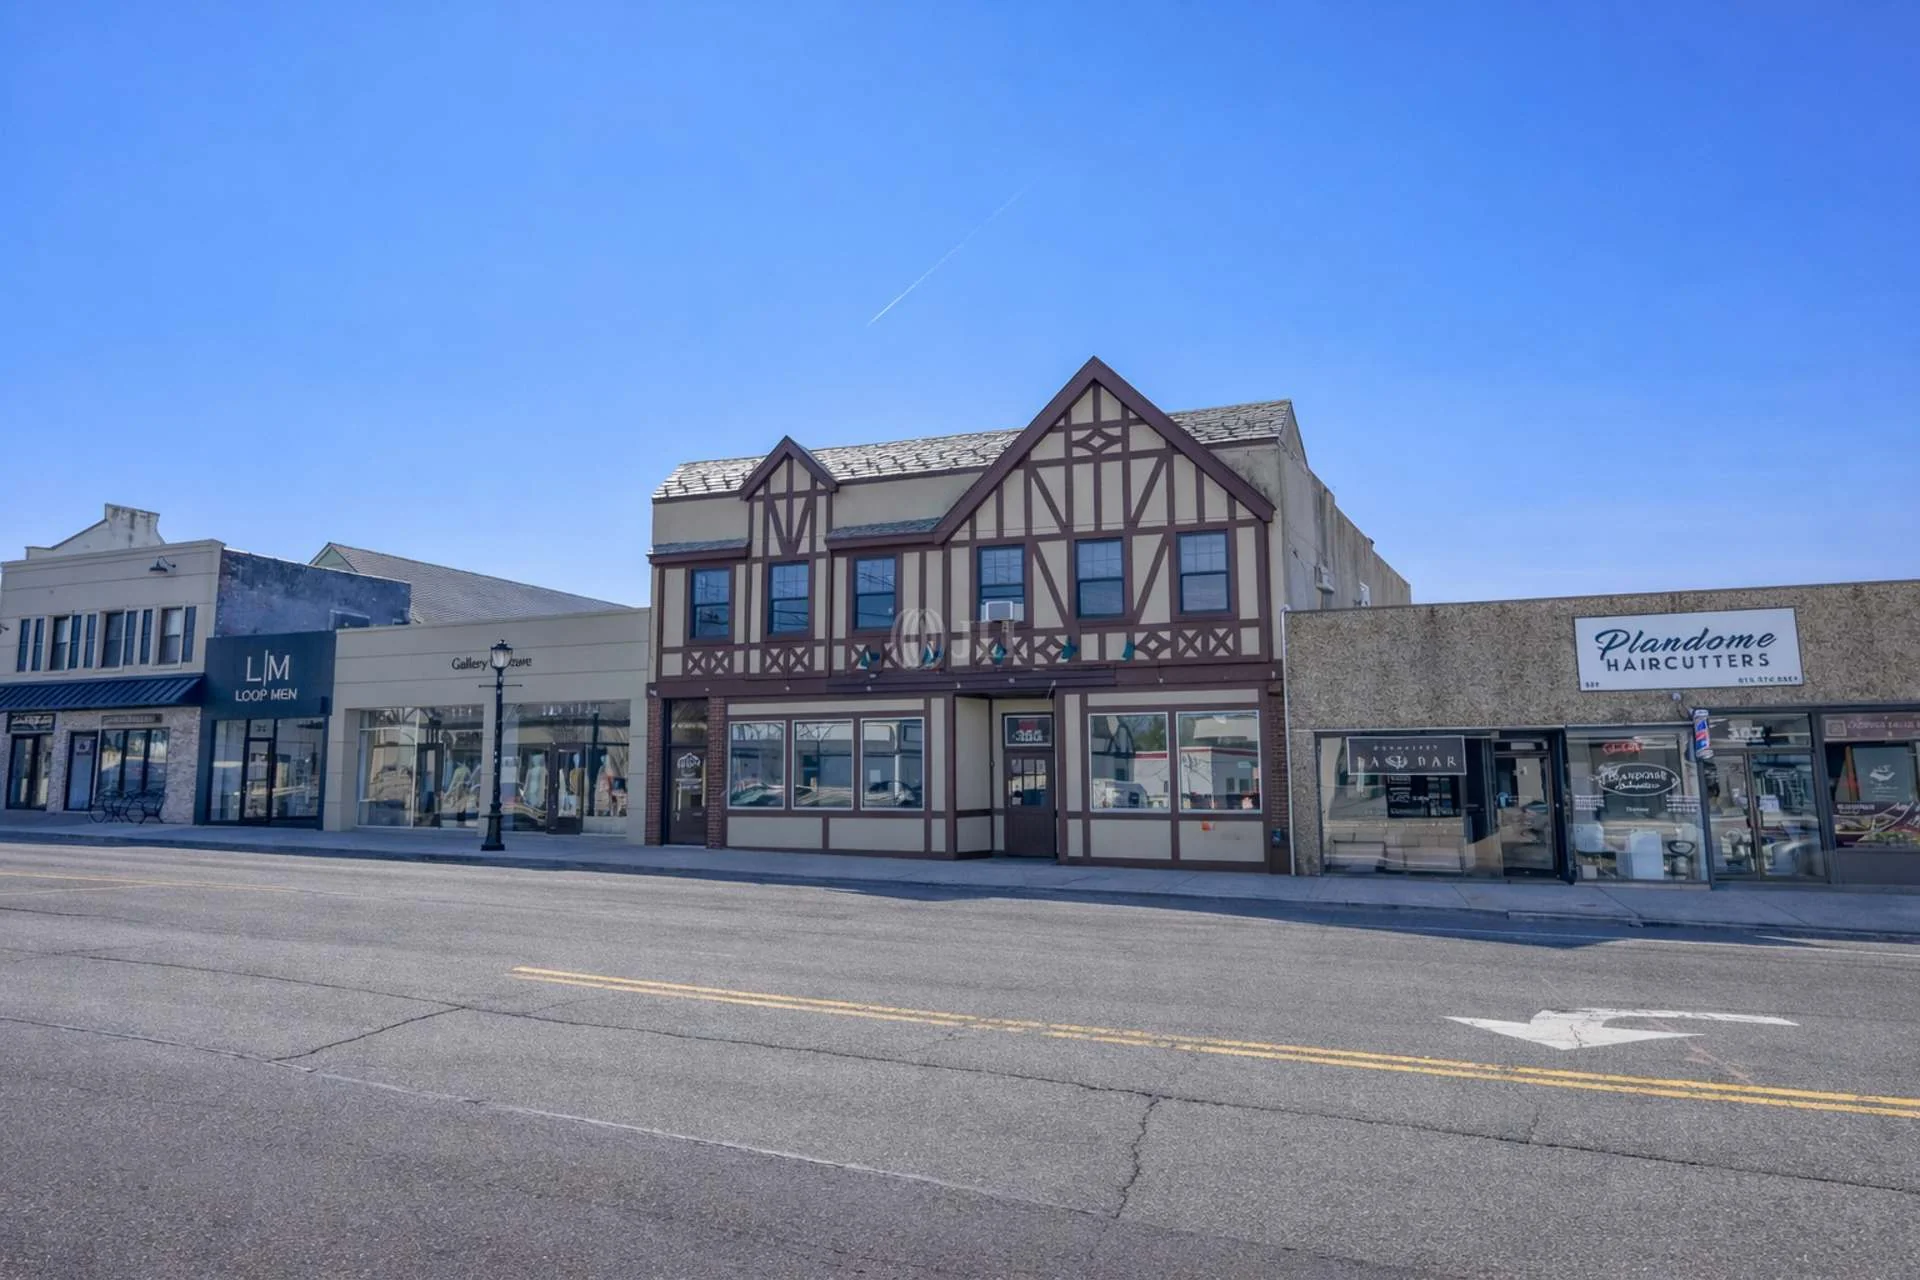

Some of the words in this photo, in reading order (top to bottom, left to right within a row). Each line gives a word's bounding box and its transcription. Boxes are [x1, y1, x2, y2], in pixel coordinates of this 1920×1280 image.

[1595, 628, 1776, 660] Plandome
[452, 656, 488, 671] Gallery
[1607, 653, 1770, 672] HAIRCUTTERS
[235, 689, 267, 702] LOOP
[270, 688, 297, 700] MEN
